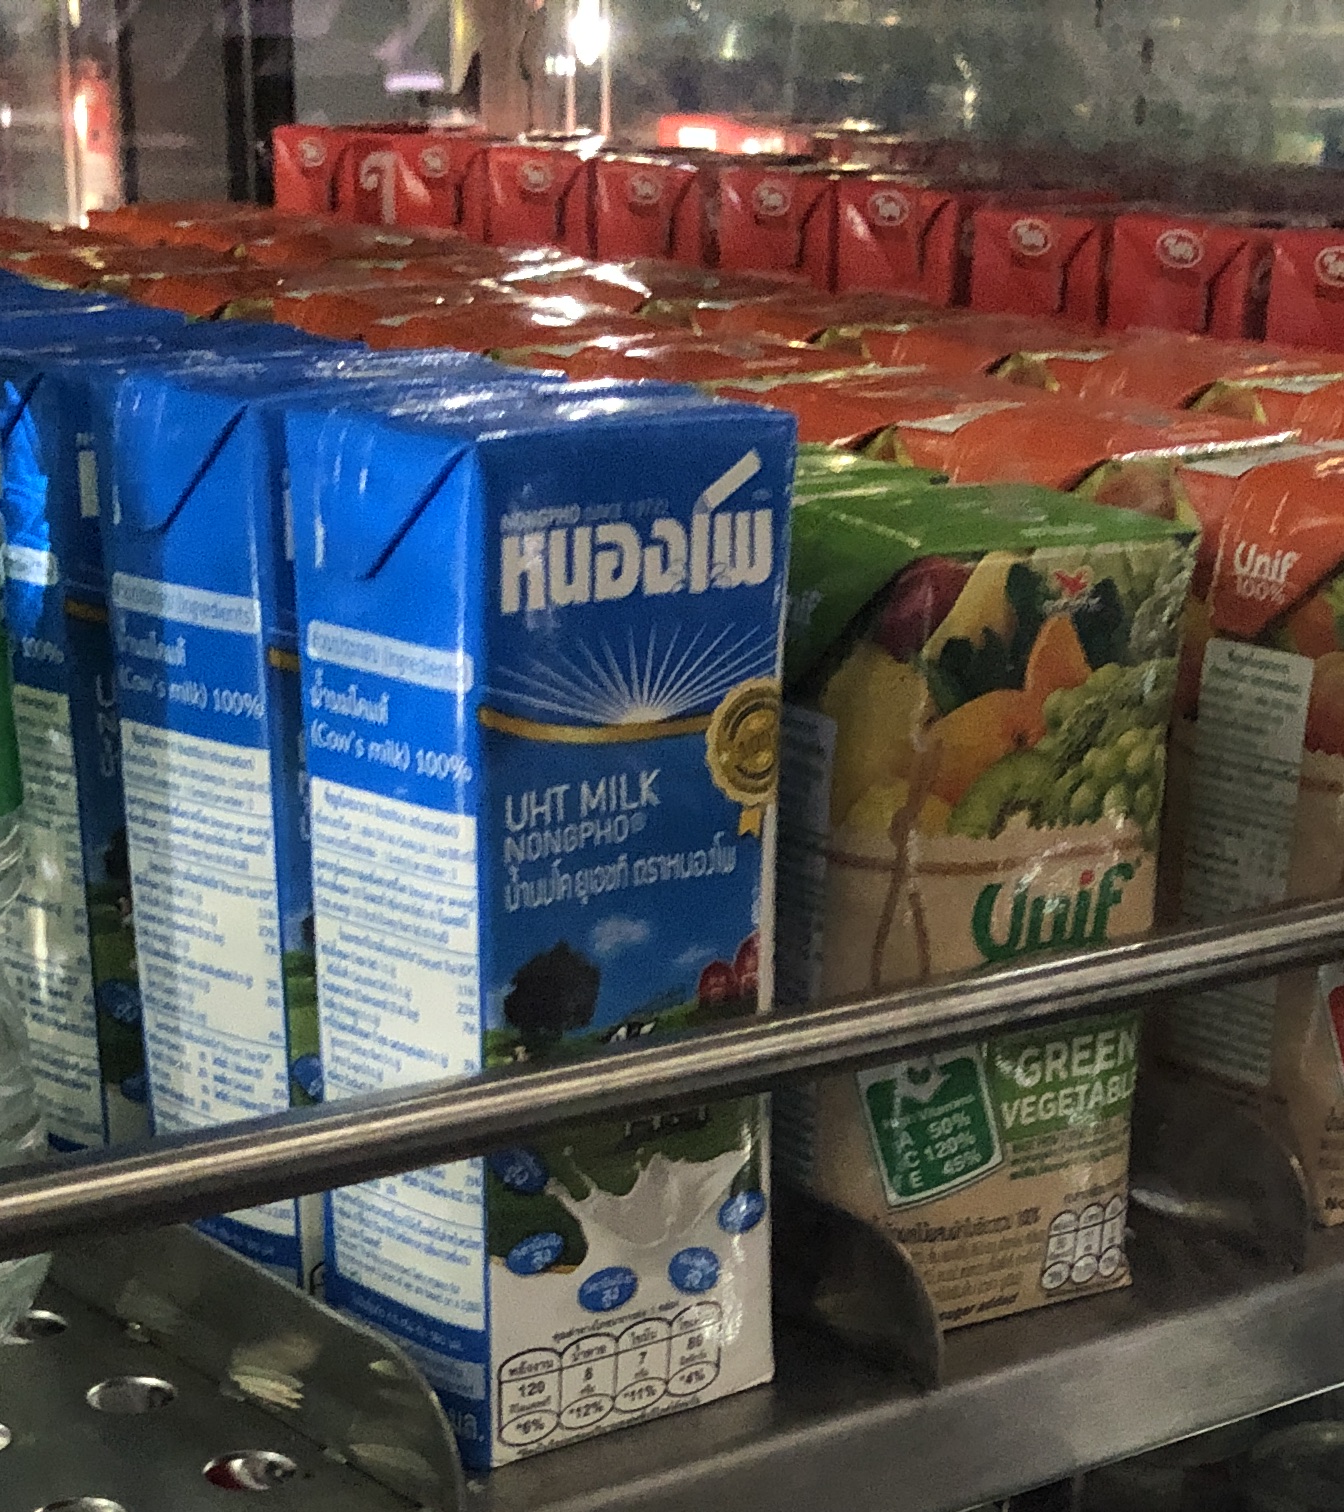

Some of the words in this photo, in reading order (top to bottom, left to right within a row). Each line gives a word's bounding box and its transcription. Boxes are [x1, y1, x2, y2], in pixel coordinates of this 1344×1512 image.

[1234, 540, 1302, 583] Unif
[213, 688, 266, 720] 100%
[367, 738, 412, 773] milk)
[416, 749, 474, 784] 100%
[505, 784, 571, 832] UHT
[580, 768, 662, 818] MILK
[972, 855, 1142, 963] Unif
[1016, 1030, 1138, 1088] GREEN
[926, 1110, 972, 1140] 50%
[904, 1150, 921, 1169] C
[908, 1170, 925, 1189] E
[638, 1350, 649, 1366] 7
[518, 1379, 547, 1399] 120
